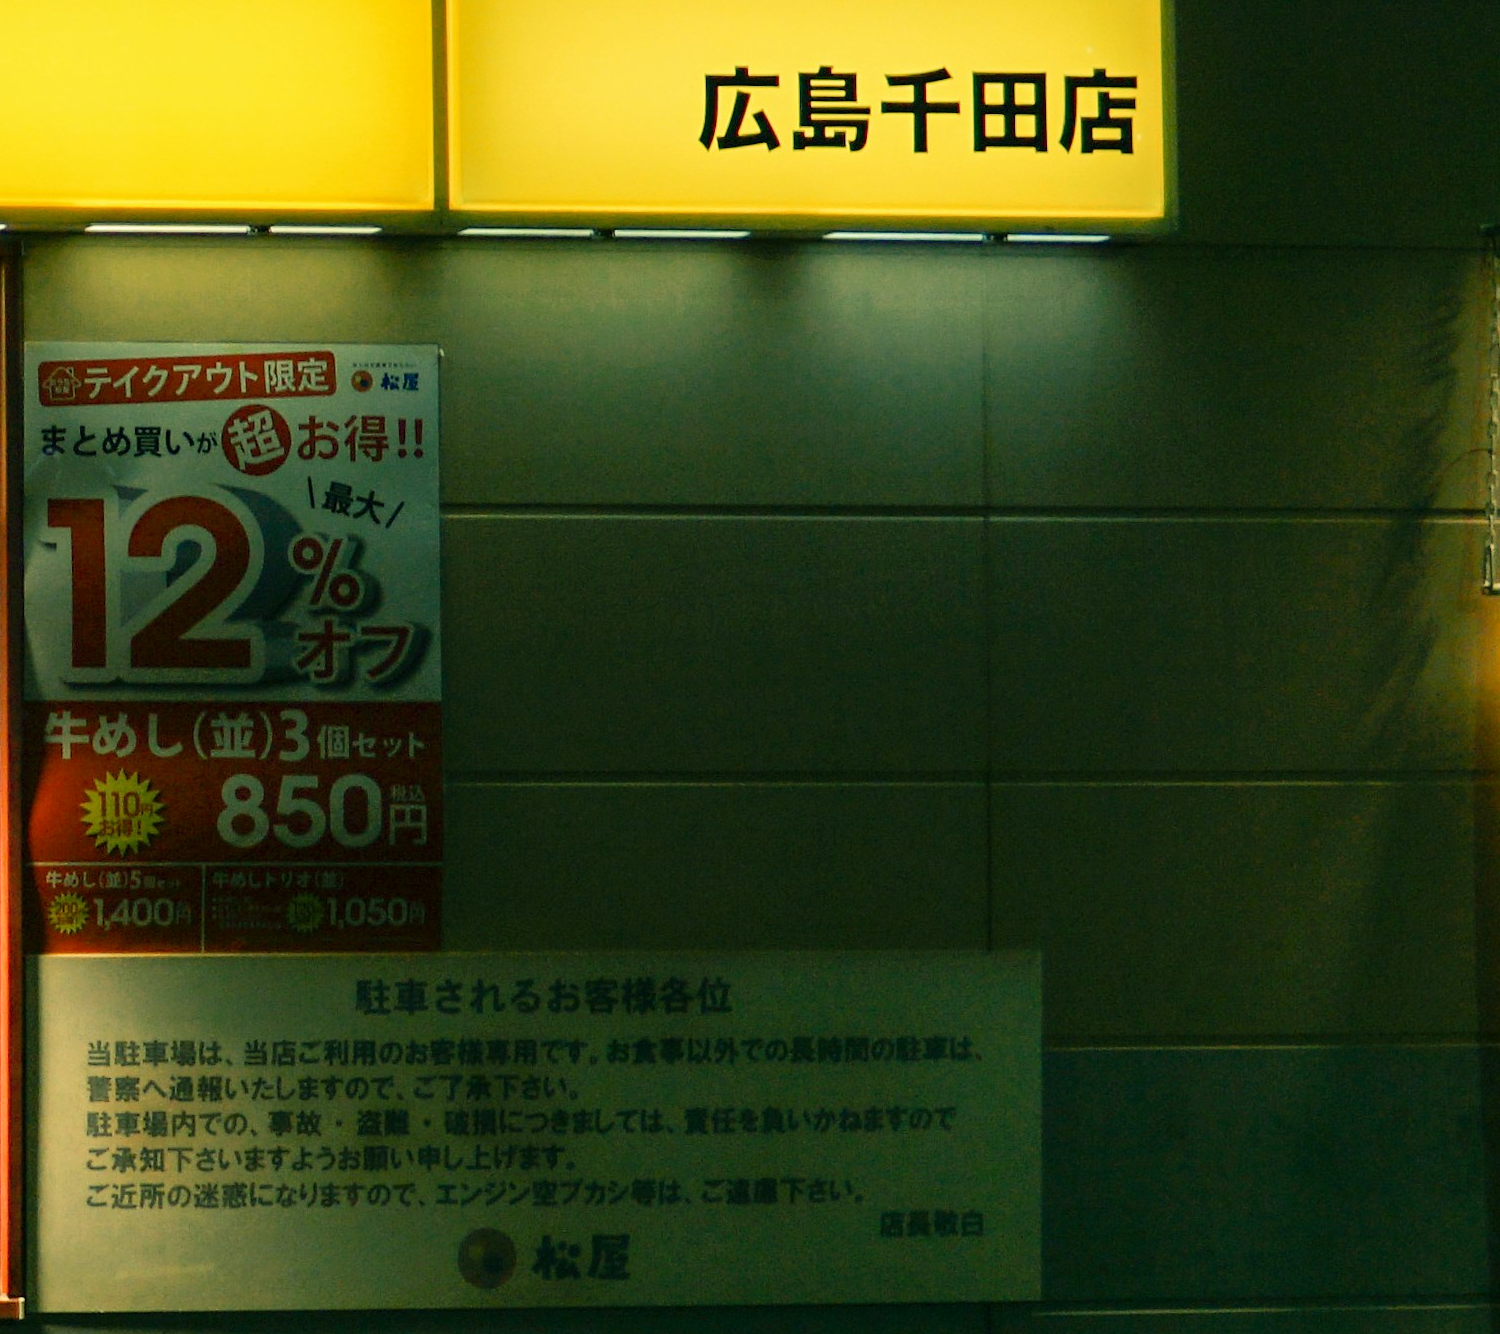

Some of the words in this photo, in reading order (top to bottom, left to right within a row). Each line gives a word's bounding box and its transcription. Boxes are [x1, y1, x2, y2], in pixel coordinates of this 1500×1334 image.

[699, 66, 1138, 154] 広島千田店
[84, 358, 330, 399] テイクアウト限定
[380, 372, 419, 391] 松屋
[323, 481, 385, 524] 最大
[355, 977, 733, 1017] 駐車されるお客様各位
[534, 1234, 631, 1282] 松屋
